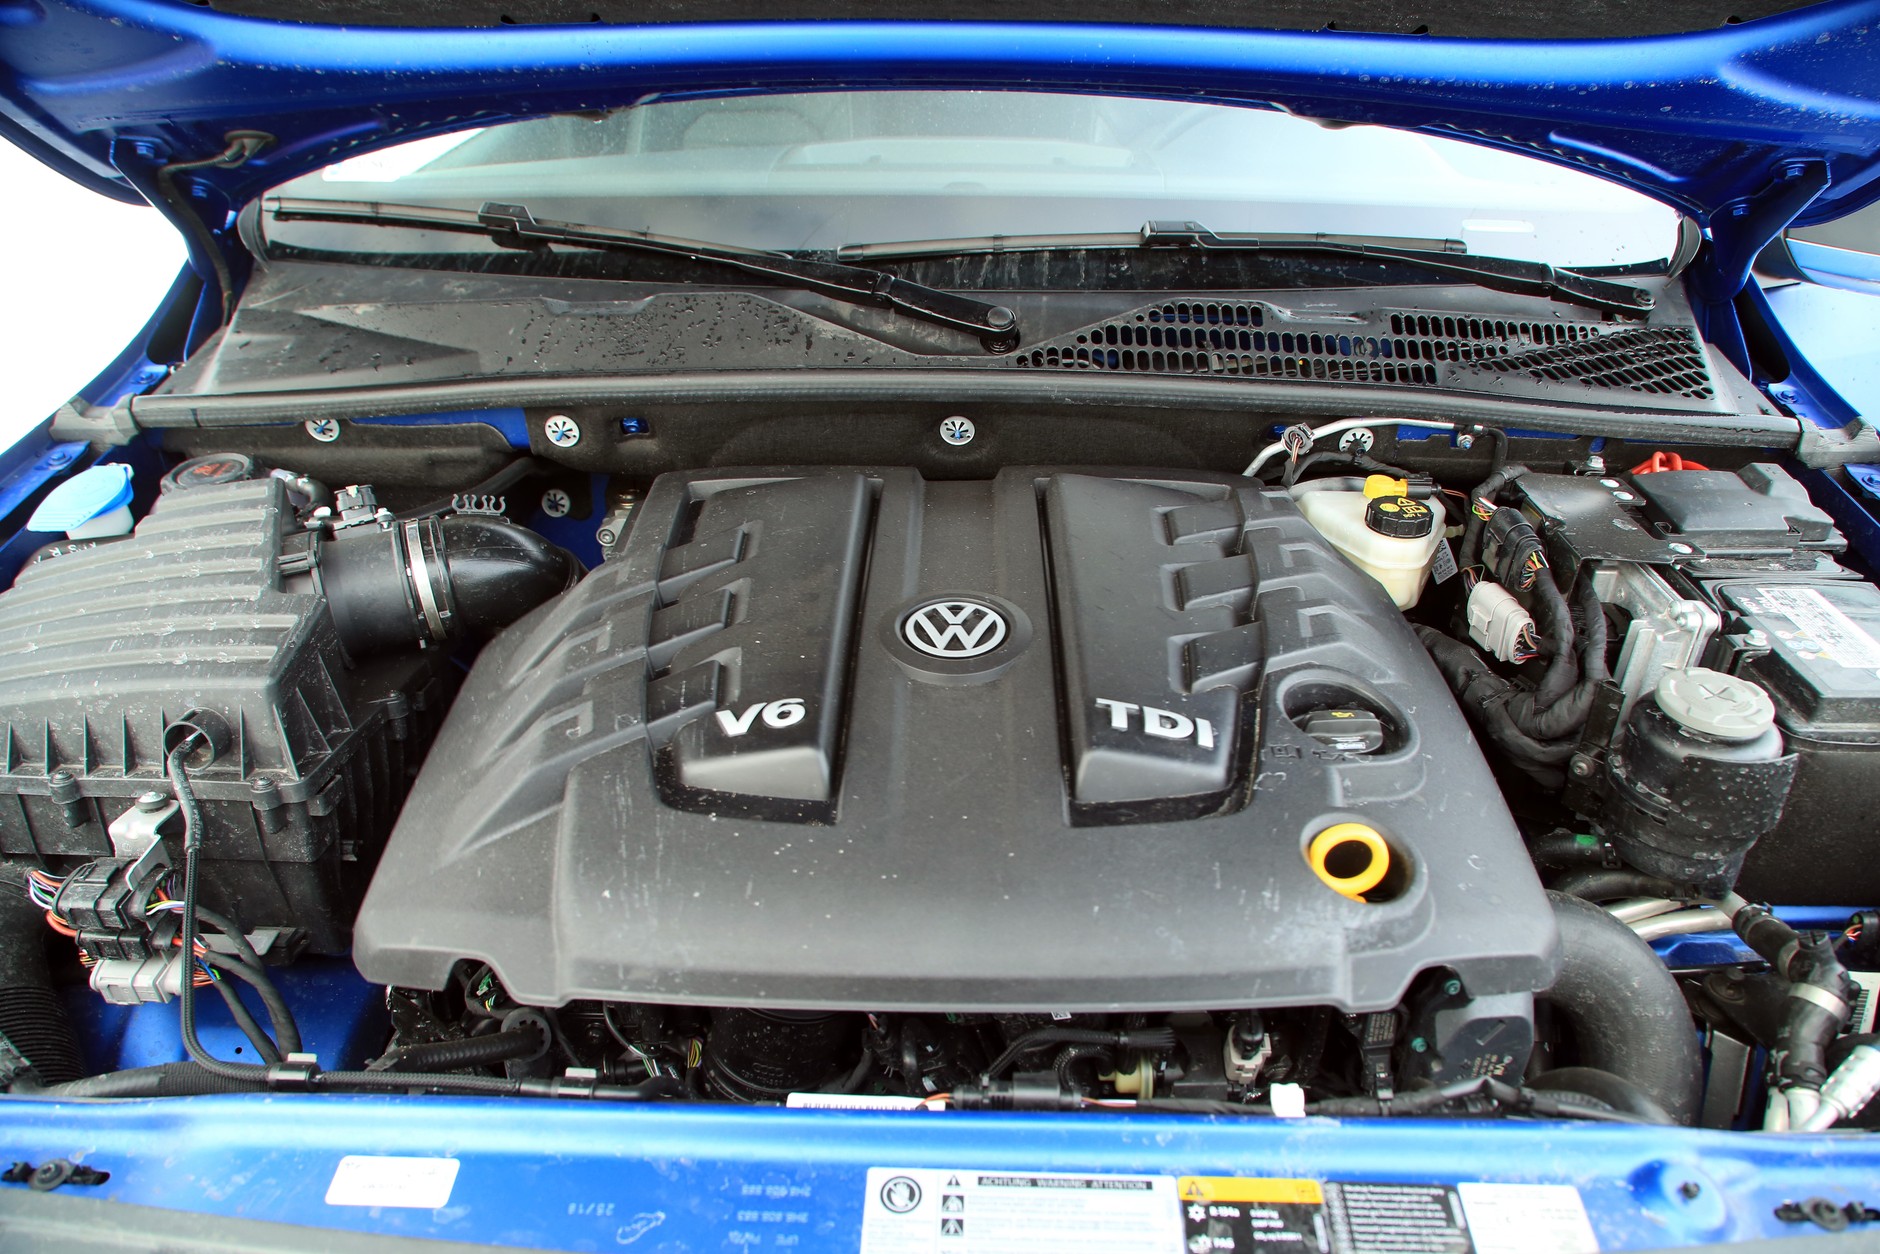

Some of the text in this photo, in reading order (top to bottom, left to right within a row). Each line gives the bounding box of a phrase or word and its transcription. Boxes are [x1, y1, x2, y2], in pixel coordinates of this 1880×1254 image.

[907, 603, 1005, 657] VW
[716, 697, 807, 737] V6
[1095, 697, 1215, 750] TDI
[981, 1176, 1147, 1190] ACHTUNG WARNING ATTENTION
